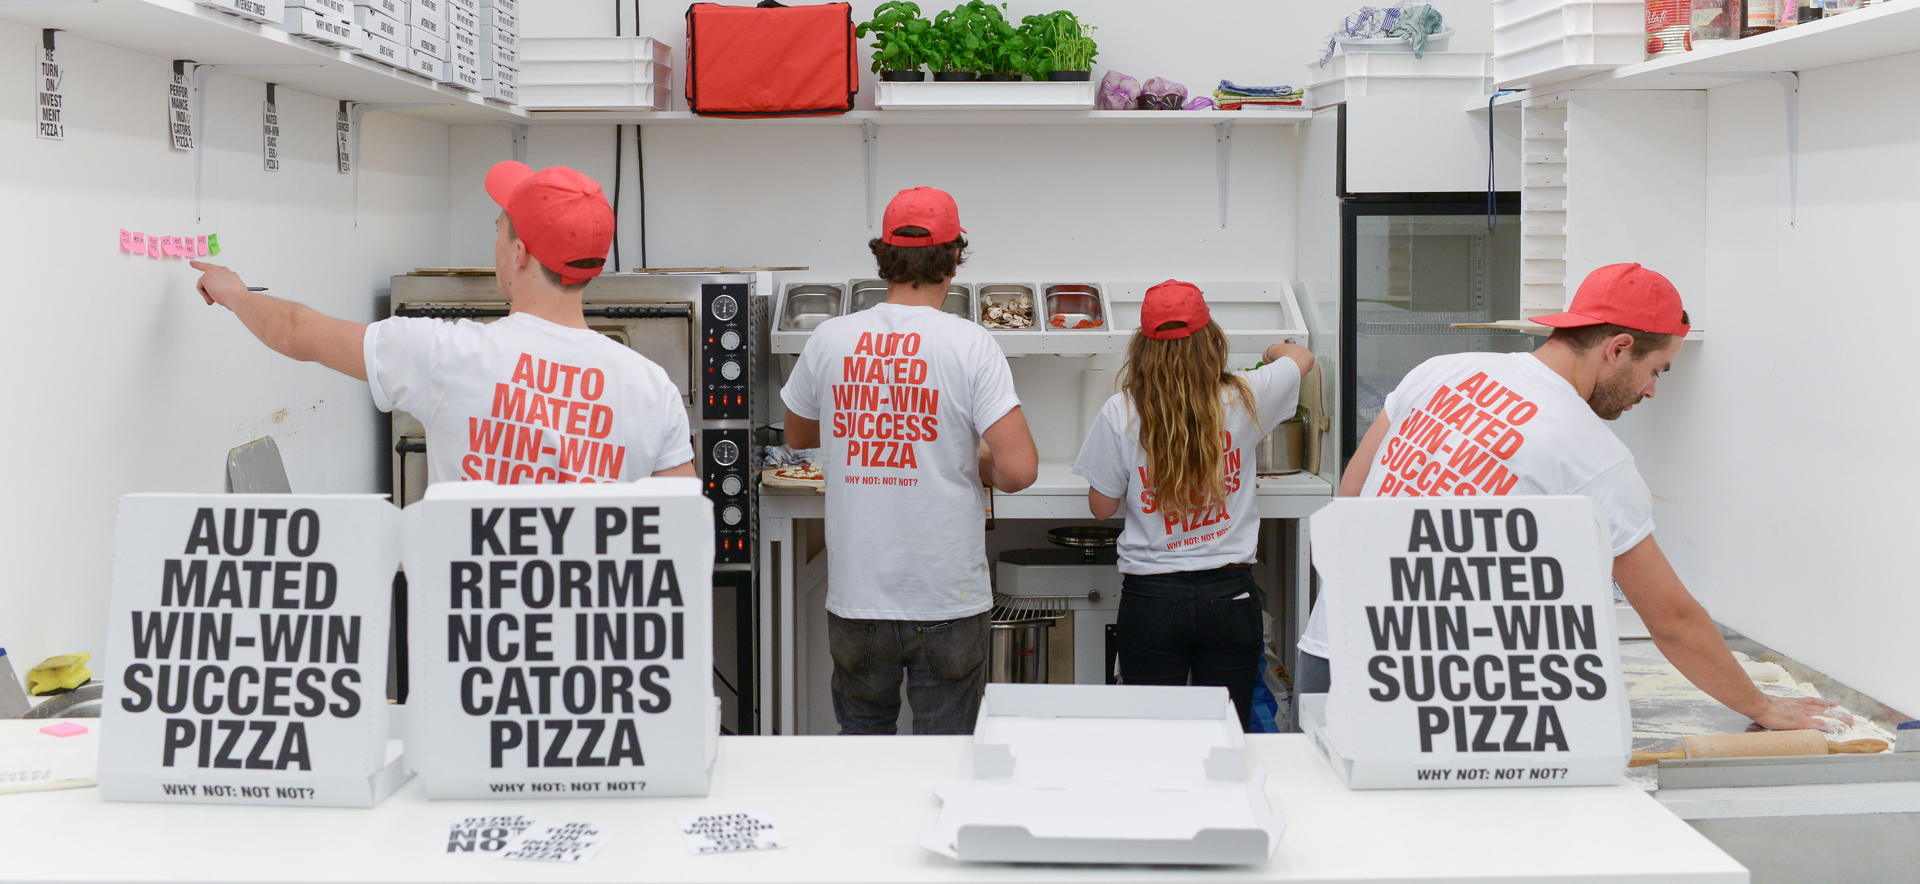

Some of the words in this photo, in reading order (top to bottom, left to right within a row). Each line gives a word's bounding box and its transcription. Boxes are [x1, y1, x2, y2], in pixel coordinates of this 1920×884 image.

[253, 2, 266, 16] TIMES
[42, 62, 58, 77] TURN
[45, 49, 54, 62] RE
[46, 78, 55, 92] ON
[170, 83, 188, 98] PERFOR
[174, 72, 183, 84] KEY
[40, 91, 62, 108] INVEST
[42, 107, 60, 122] MENT
[171, 96, 188, 111] MANCE
[40, 122, 58, 137] PIZZA
[60, 124, 63, 137] 1
[173, 122, 191, 136] CATORS
[175, 135, 189, 148] PIZZA
[190, 137, 193, 149] 2
[854, 332, 921, 357] AUTO
[511, 352, 604, 401] AUTO
[844, 356, 928, 385] MATED
[491, 382, 613, 439] MATED
[832, 385, 939, 415] WIN-WIN
[1455, 371, 1538, 426] AUTO
[832, 412, 938, 442] SUCCESS
[1425, 384, 1524, 460] MATED
[469, 416, 626, 480] WIN-WIN
[846, 440, 918, 469] PIZZA
[1398, 407, 1519, 496] WIN-WIN
[845, 475, 860, 485] WHY
[862, 476, 880, 485] NOT:
[882, 477, 897, 486] NOT
[898, 478, 918, 487] NOT?
[184, 507, 320, 557] AUTO
[471, 507, 575, 556] KEY
[594, 506, 660, 555] PE
[1166, 539, 1182, 550] WHY
[1184, 536, 1200, 547] NOT:
[1201, 532, 1215, 543] NOT
[1407, 508, 1538, 553] AUTO
[161, 559, 337, 610] MATED
[450, 559, 684, 609] RFORMA
[1389, 556, 1564, 601] MATED
[131, 611, 361, 664] WIN-WIN
[448, 613, 553, 663] NCE
[575, 611, 684, 661] INDI
[1365, 605, 1598, 651] WIN-WIN
[121, 663, 361, 718] SUCCESS
[460, 664, 671, 716] CATORS
[1367, 654, 1607, 702] SUCCESS
[490, 718, 645, 769] PIZZA
[1417, 705, 1570, 752] PIZZA
[162, 718, 312, 771] PIZZA
[489, 783, 525, 793] WHY
[531, 783, 566, 793] NOT:
[571, 782, 602, 792] NOT
[606, 781, 647, 791] NOT?
[1417, 769, 1453, 780] WHY
[1456, 769, 1490, 780] NOT:
[1494, 768, 1525, 779] NOT
[1529, 767, 1568, 779] NOT?
[162, 784, 197, 796] WHY
[203, 785, 237, 797] NOT:
[241, 786, 272, 798] NOT
[276, 787, 315, 799] NOT?
[698, 813, 748, 822] AUTO
